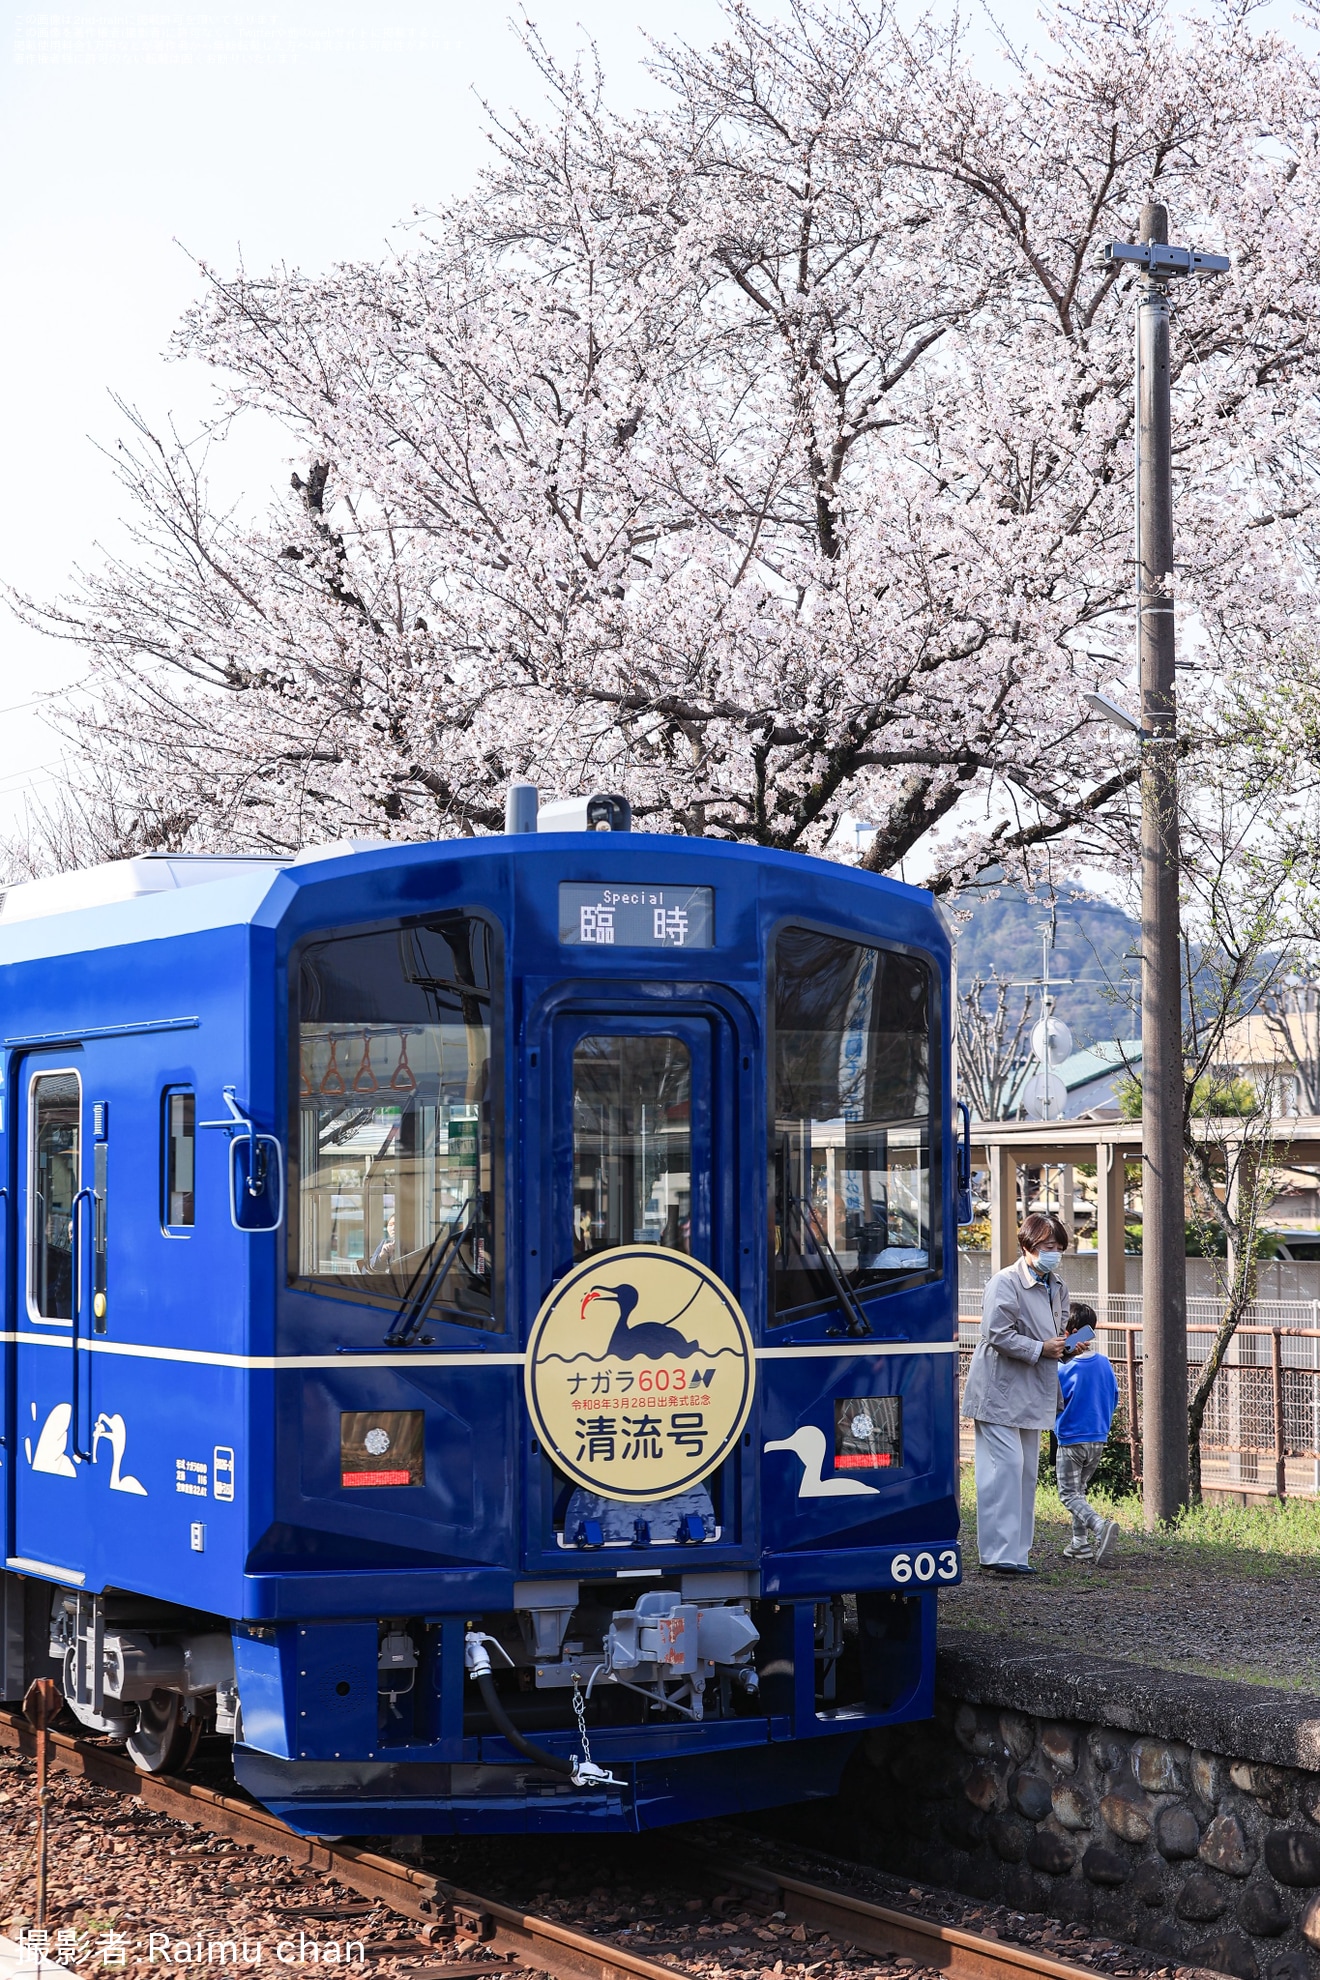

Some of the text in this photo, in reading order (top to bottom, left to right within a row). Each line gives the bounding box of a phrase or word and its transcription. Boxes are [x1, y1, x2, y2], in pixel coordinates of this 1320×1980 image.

[603, 890, 664, 905] Special
[580, 903, 689, 946] 臨時
[571, 1394, 712, 1411] 令和8年3月28日出発式記念
[575, 1412, 709, 1463] 清流号
[891, 1550, 958, 1583] 603
